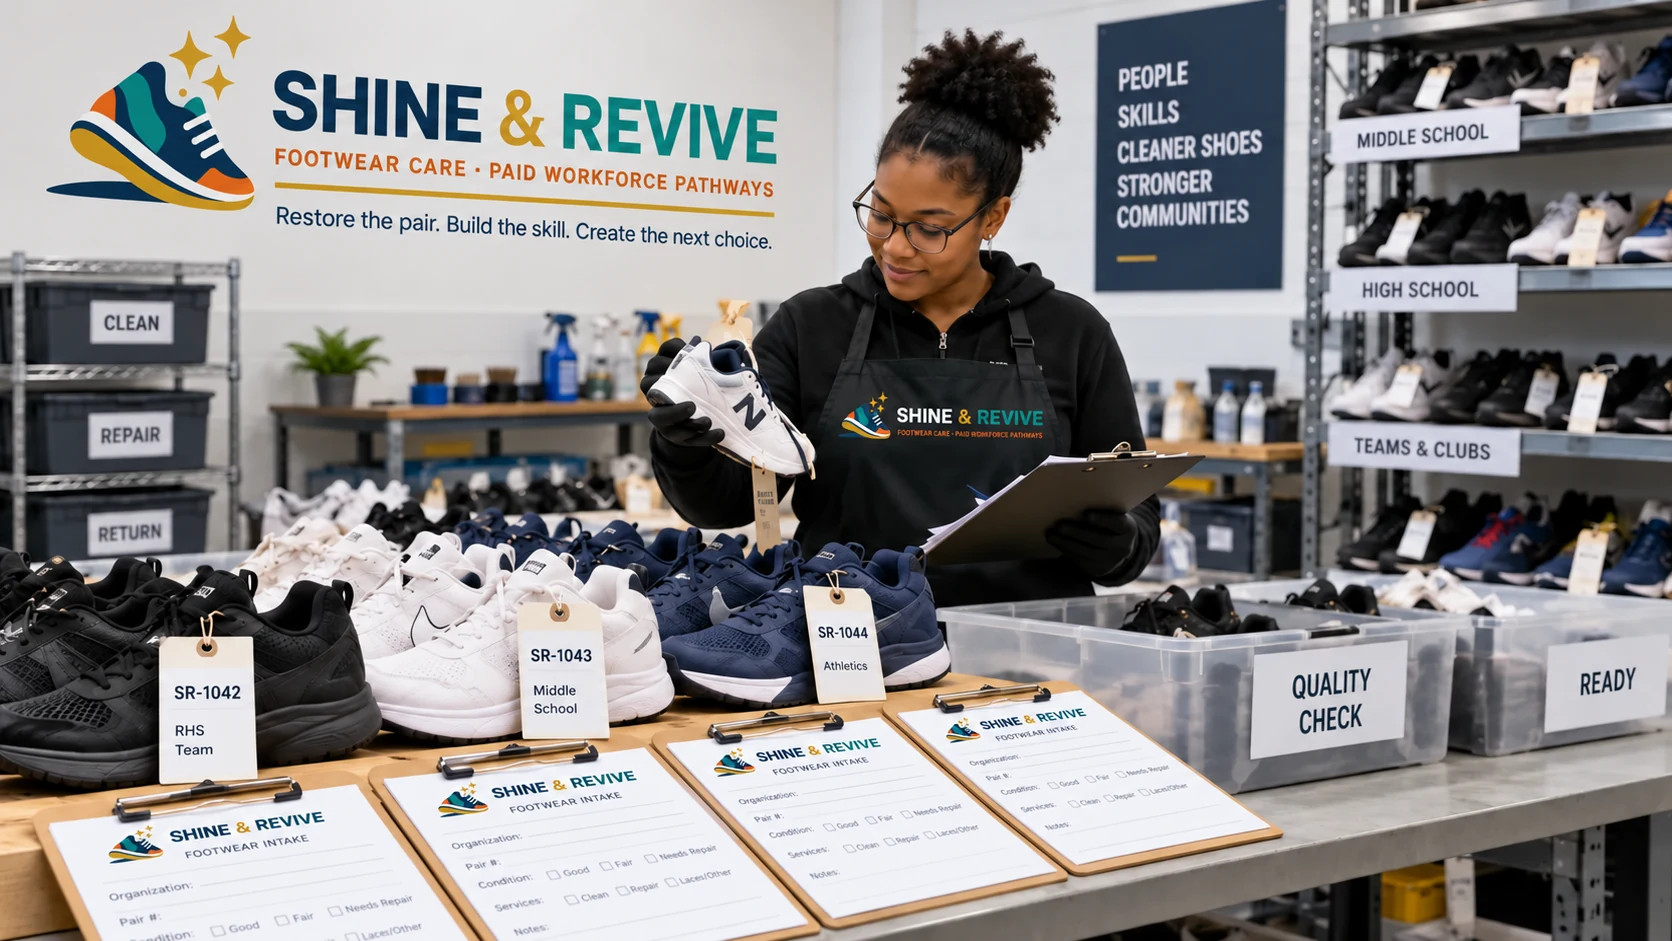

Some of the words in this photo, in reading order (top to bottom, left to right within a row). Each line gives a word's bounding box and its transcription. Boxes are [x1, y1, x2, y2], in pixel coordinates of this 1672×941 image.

[1118, 60, 1189, 92] PEOPLE
[272, 69, 483, 143] SHINE
[499, 89, 545, 147] &
[562, 92, 778, 165] REVIVE
[1117, 99, 1180, 129] SKILLS
[1356, 128, 1417, 149] MIDDLE
[1421, 123, 1489, 144] SCHOOL
[1117, 135, 1197, 164] CLEANER
[1200, 129, 1263, 158] SHOES
[274, 147, 400, 173] FOOTWEAR
[408, 156, 467, 177] CARE
[489, 161, 536, 182] PAID
[544, 165, 667, 190] WORKFORCE
[675, 175, 774, 198] PATHWAYS
[1117, 169, 1213, 198] STRONGER
[1116, 198, 1250, 229] COMMUNITIES
[276, 206, 356, 228] Restore
[360, 210, 394, 230] the
[399, 213, 441, 235] pair.
[446, 214, 493, 235] Build
[497, 218, 527, 237] the
[531, 219, 570, 240] skill.
[575, 222, 636, 243] Create
[640, 225, 669, 245] the
[672, 229, 710, 247] next
[713, 229, 773, 250] choice.
[1362, 281, 1403, 299] HIGH
[1408, 280, 1480, 298] SCHOOL
[103, 314, 160, 332] CLEAN
[896, 407, 953, 425] SHINE
[957, 408, 972, 425] &
[977, 409, 1044, 426] REVIVE
[100, 426, 161, 444] REPAIR
[897, 429, 933, 437] FOOTWEAR
[1354, 437, 1411, 456] TEAMS
[1416, 440, 1429, 457] &
[1433, 441, 1491, 460] CLUBS
[98, 523, 162, 542] RETURN
[817, 624, 870, 641] SR-1044
[530, 648, 593, 664] SR-1043
[823, 659, 868, 672] Athletics
[533, 684, 577, 697] Middle
[1291, 667, 1372, 700] QUALITY
[1580, 667, 1637, 696] READY
[173, 684, 242, 701] SR-1042
[533, 702, 578, 715] School
[980, 717, 1022, 730] SHINE
[1024, 714, 1036, 724] &
[1037, 708, 1086, 722] REVIVE
[1298, 703, 1363, 735] CHECK
[174, 724, 205, 737] RHS
[995, 729, 1045, 742] FOOTWEAR
[1046, 725, 1078, 735] INTAKE
[174, 743, 214, 757] Team
[756, 747, 806, 763] SHINE
[808, 745, 821, 756] &
[823, 738, 881, 754] REVIVE
[969, 753, 1021, 767] Organization:
[772, 762, 830, 776] FOOTWEAR
[832, 757, 869, 768] INTAKE
[491, 782, 548, 799] SHINE
[553, 779, 567, 791] &
[570, 770, 637, 789] REVIVE
[986, 774, 1003, 782] Pair
[1000, 784, 1040, 796] Condition:
[1059, 779, 1080, 788] Good
[1125, 767, 1149, 778] Needs
[1149, 764, 1170, 774] Repair
[509, 798, 577, 814] FOOTWEAR
[580, 792, 622, 804] INTAKE
[738, 790, 798, 806] Organization:
[1020, 801, 1057, 814] Services:
[1079, 798, 1101, 807] Clean
[1113, 792, 1136, 802] Repair
[1149, 782, 1188, 796] Laces/Other
[169, 823, 231, 843] SHINE
[235, 820, 251, 834] &
[255, 811, 325, 832] REVIVE
[754, 814, 773, 823] Pair
[768, 825, 815, 840] Condition:
[836, 820, 859, 830] Good
[878, 814, 894, 823] Fair
[913, 807, 937, 818] Needs
[938, 802, 962, 813] Repair
[1045, 820, 1072, 831] Notes:
[184, 841, 258, 859] FOOTWEAR
[262, 834, 310, 848] INTAKE
[451, 832, 522, 850] Organization:
[787, 845, 830, 860] Services:
[856, 841, 880, 851] Clean
[895, 834, 920, 846] Repair
[935, 823, 979, 838] Laces/Other
[465, 861, 486, 871] Pair
[478, 873, 533, 890] Condition:
[563, 866, 590, 878] Good
[614, 858, 633, 869] Fair
[658, 848, 688, 862] Needs
[689, 844, 717, 856] Repair
[809, 868, 840, 880] Notes:
[108, 881, 194, 902] Organization:
[494, 898, 544, 913] Services:
[580, 890, 610, 903] Clean
[630, 882, 660, 894] Repair
[679, 868, 732, 885] Laces/Other
[118, 914, 145, 927] Pair
[149, 912, 162, 922] #:
[228, 920, 261, 934] Good
[292, 911, 315, 923] Fair
[344, 900, 379, 914] Needs
[380, 894, 413, 908] Repair
[361, 922, 423, 941] Laces/Other
[513, 924, 550, 937] Notes:
